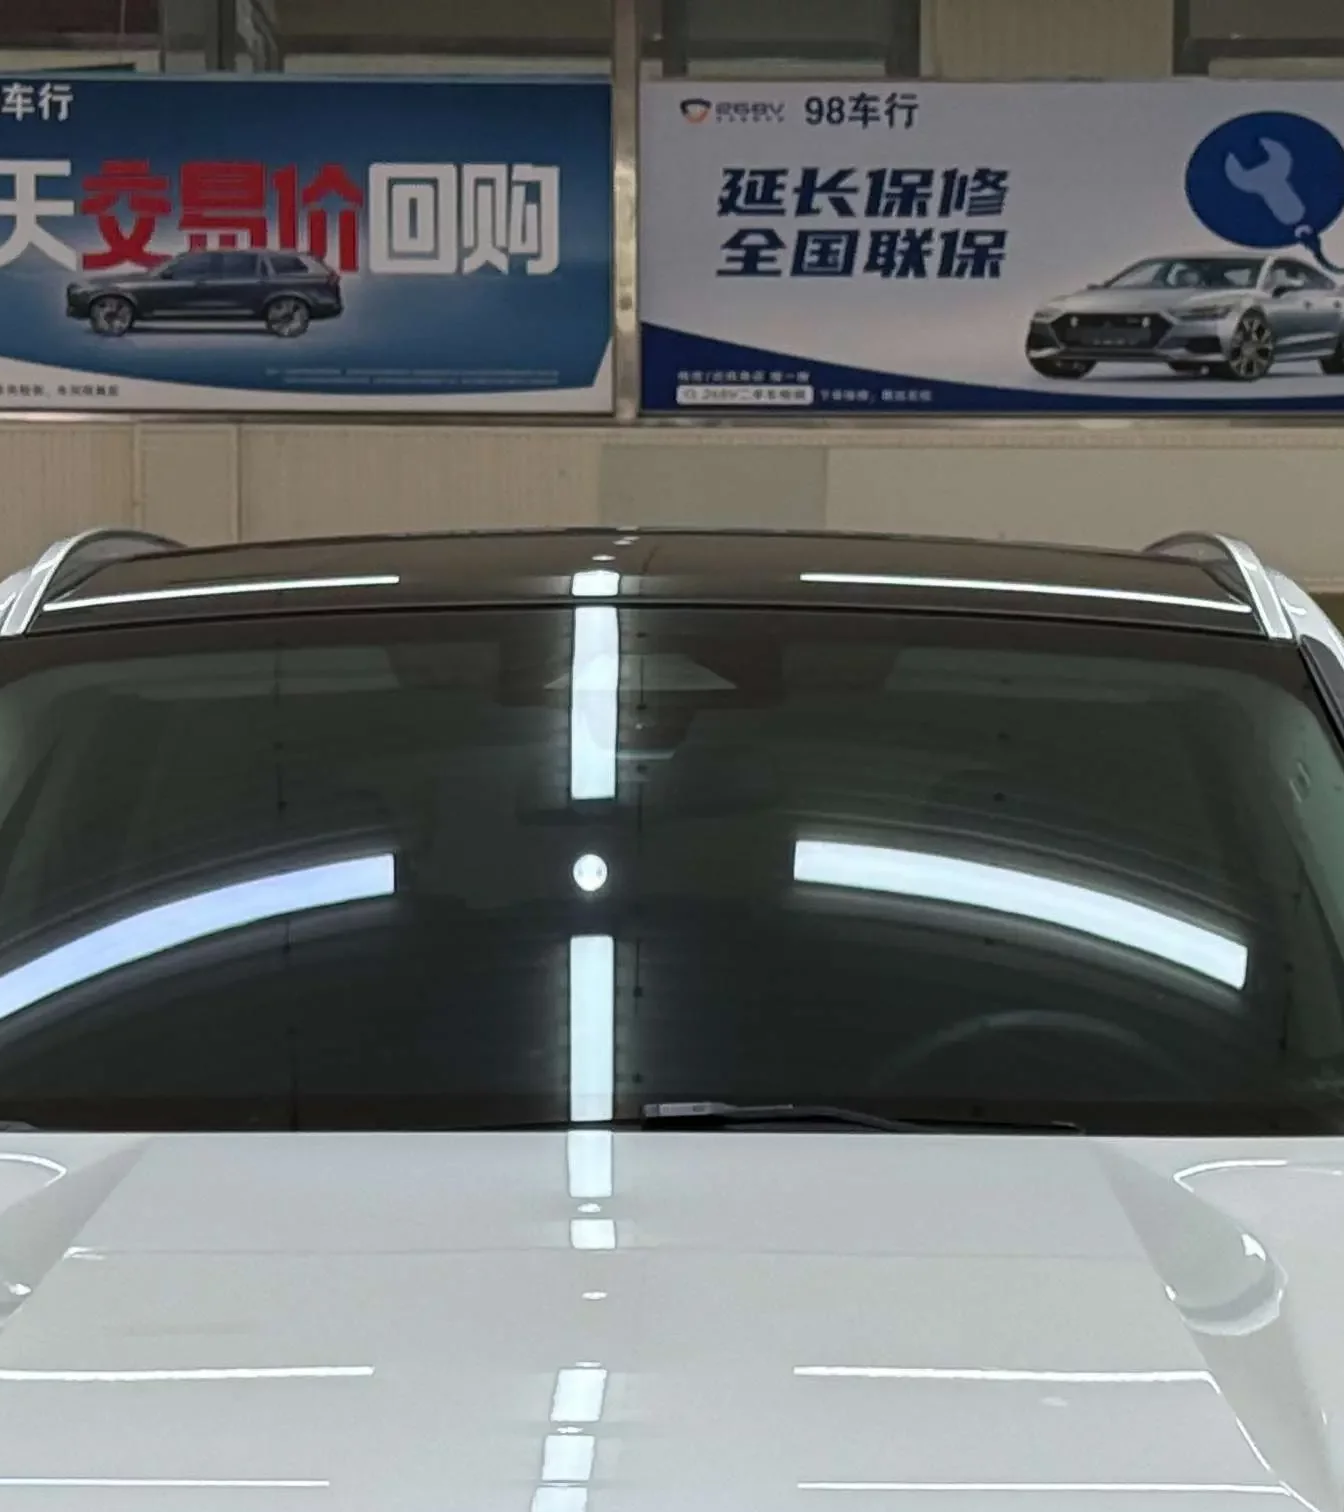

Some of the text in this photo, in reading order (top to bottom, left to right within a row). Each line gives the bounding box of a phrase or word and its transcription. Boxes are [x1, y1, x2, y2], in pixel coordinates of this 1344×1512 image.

[805, 91, 918, 129] 98车行
[717, 167, 1009, 217] 延长保修
[716, 227, 1007, 278] 全国联保
